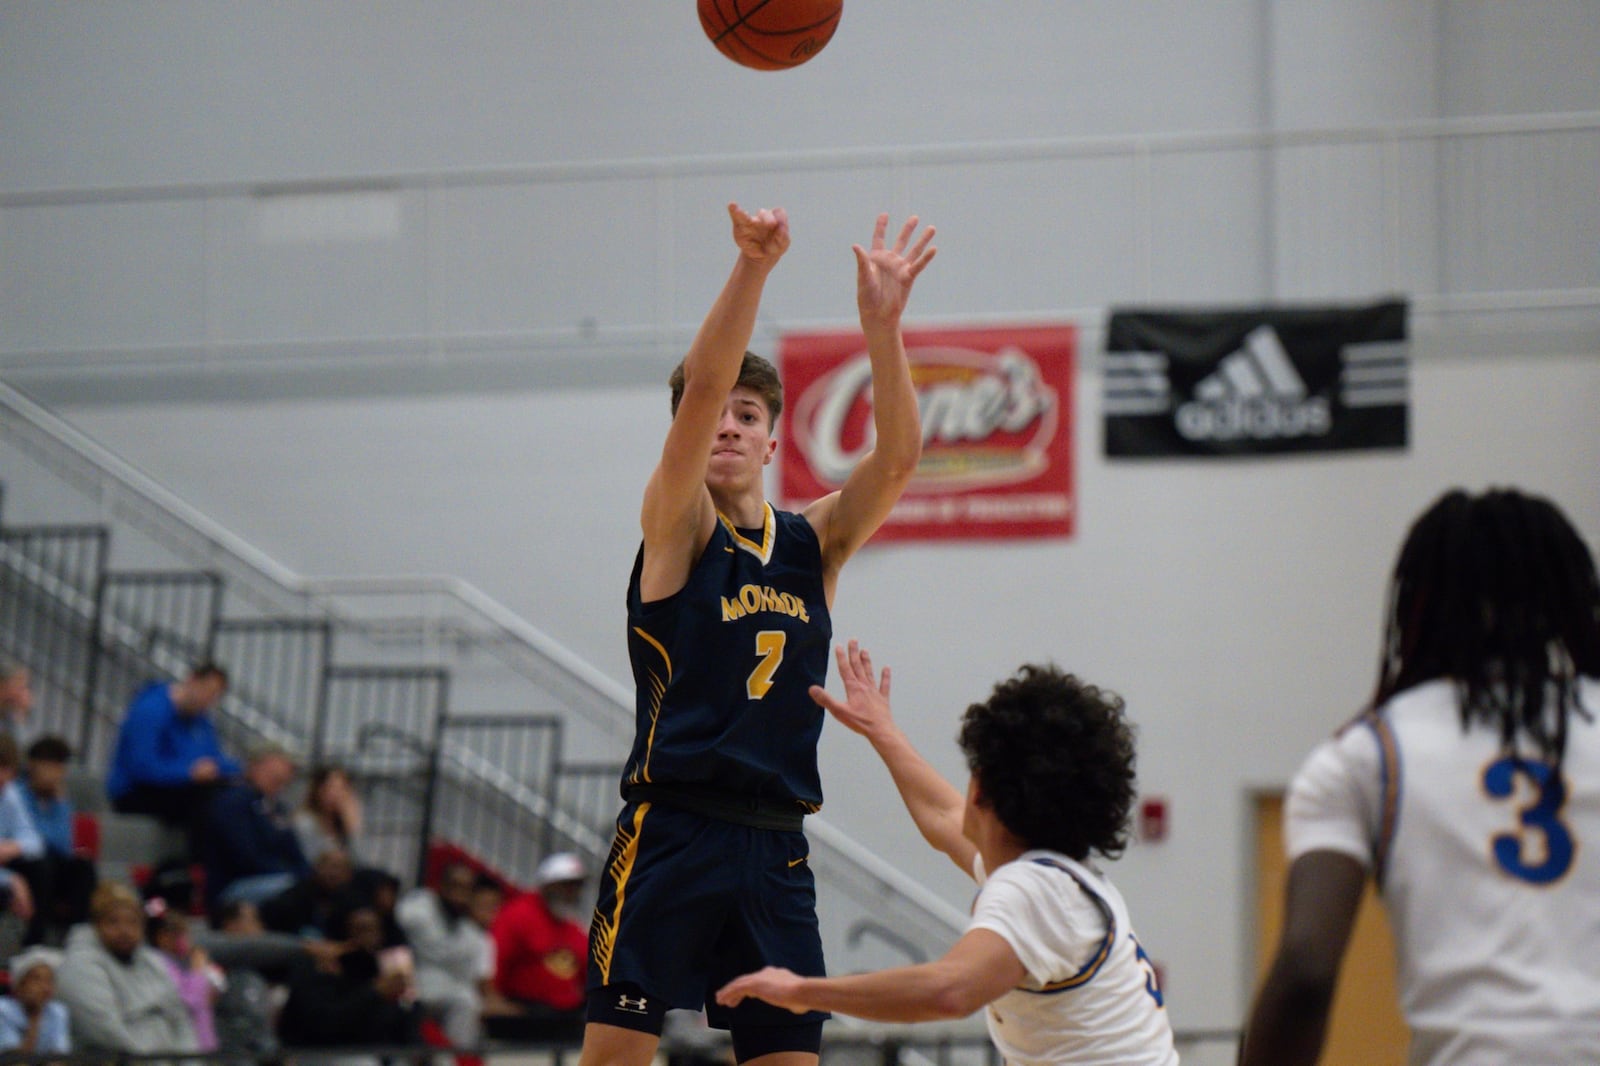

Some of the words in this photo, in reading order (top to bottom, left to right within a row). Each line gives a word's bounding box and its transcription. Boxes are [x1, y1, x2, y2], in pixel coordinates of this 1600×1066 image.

[811, 349, 1050, 480] Cne's
[1175, 396, 1332, 441] adidas
[1479, 757, 1578, 887] 3
